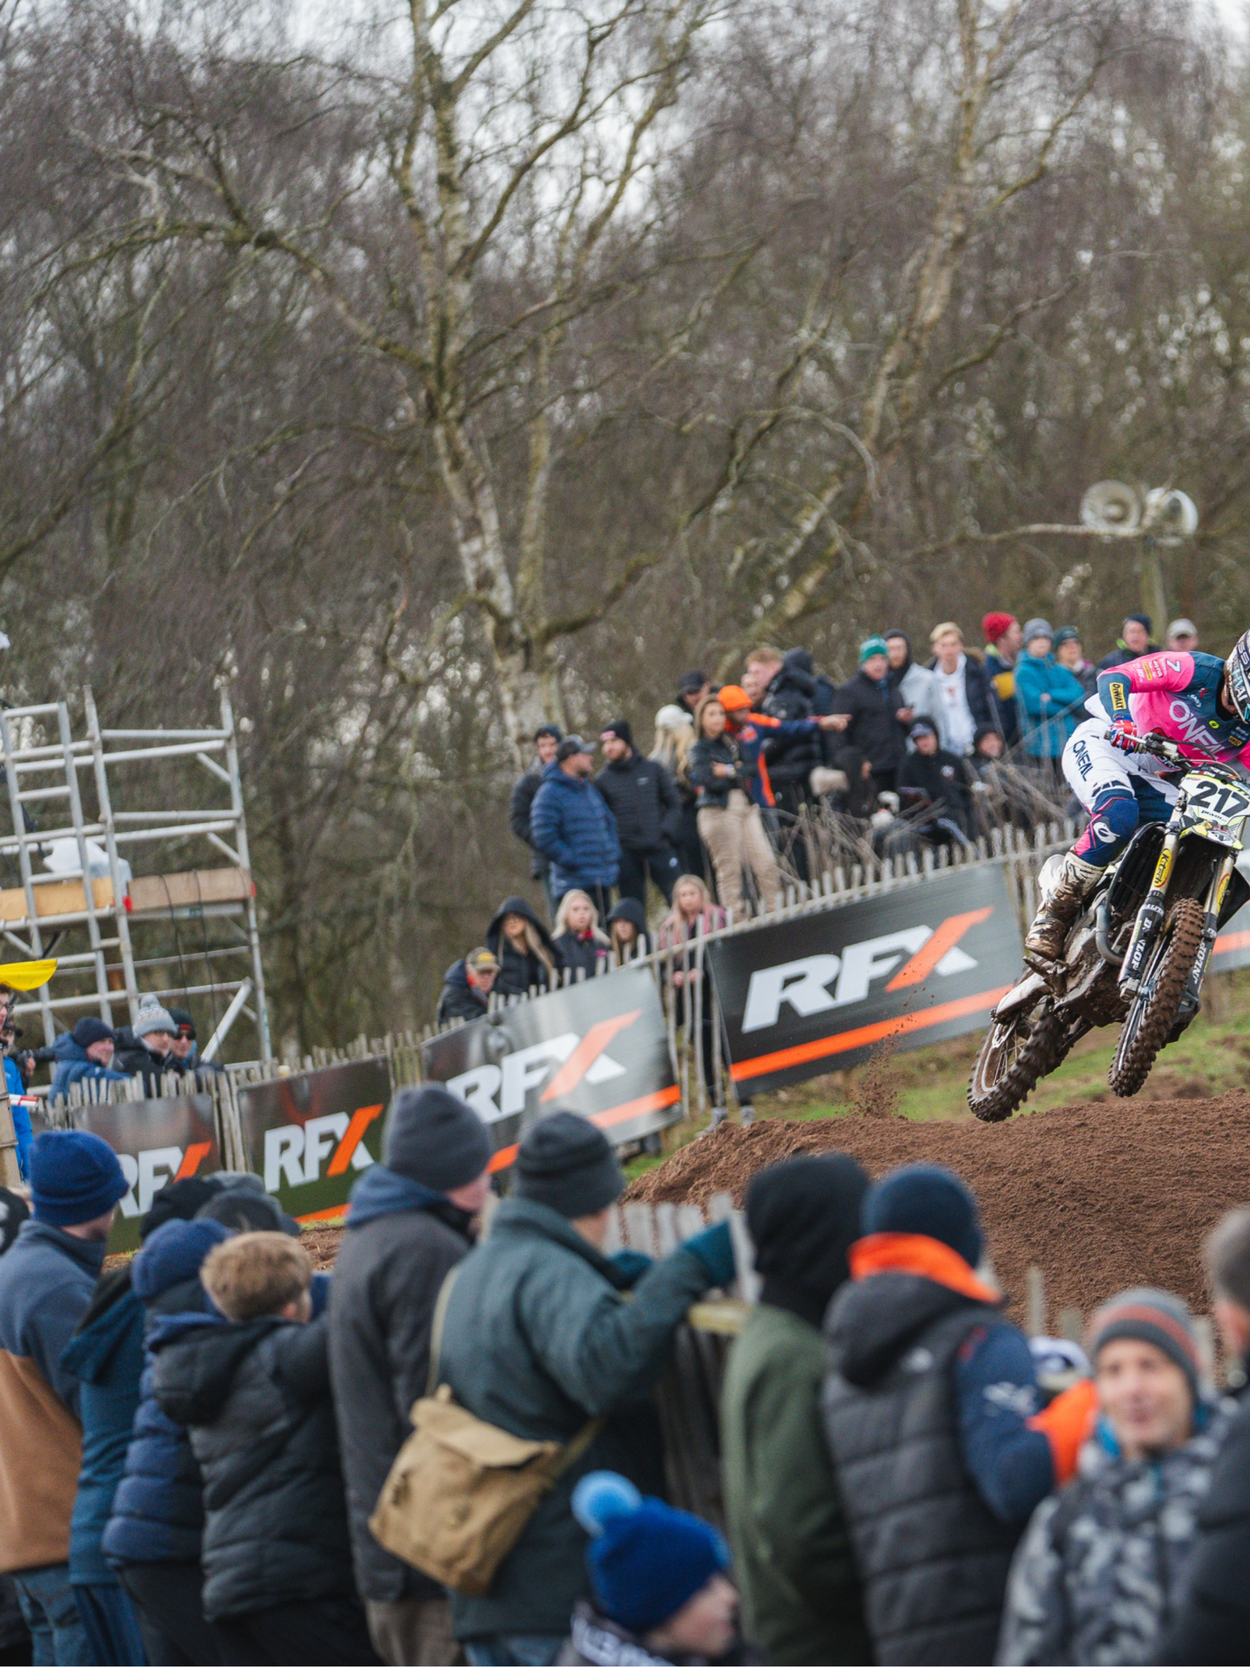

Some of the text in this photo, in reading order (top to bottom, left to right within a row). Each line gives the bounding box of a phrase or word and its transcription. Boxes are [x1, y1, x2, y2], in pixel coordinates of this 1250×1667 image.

[1166, 658, 1181, 673] 7
[1188, 780, 1250, 818] 217
[741, 905, 996, 1033] RFX
[445, 1008, 642, 1124] RFX
[263, 1103, 384, 1194] RFX
